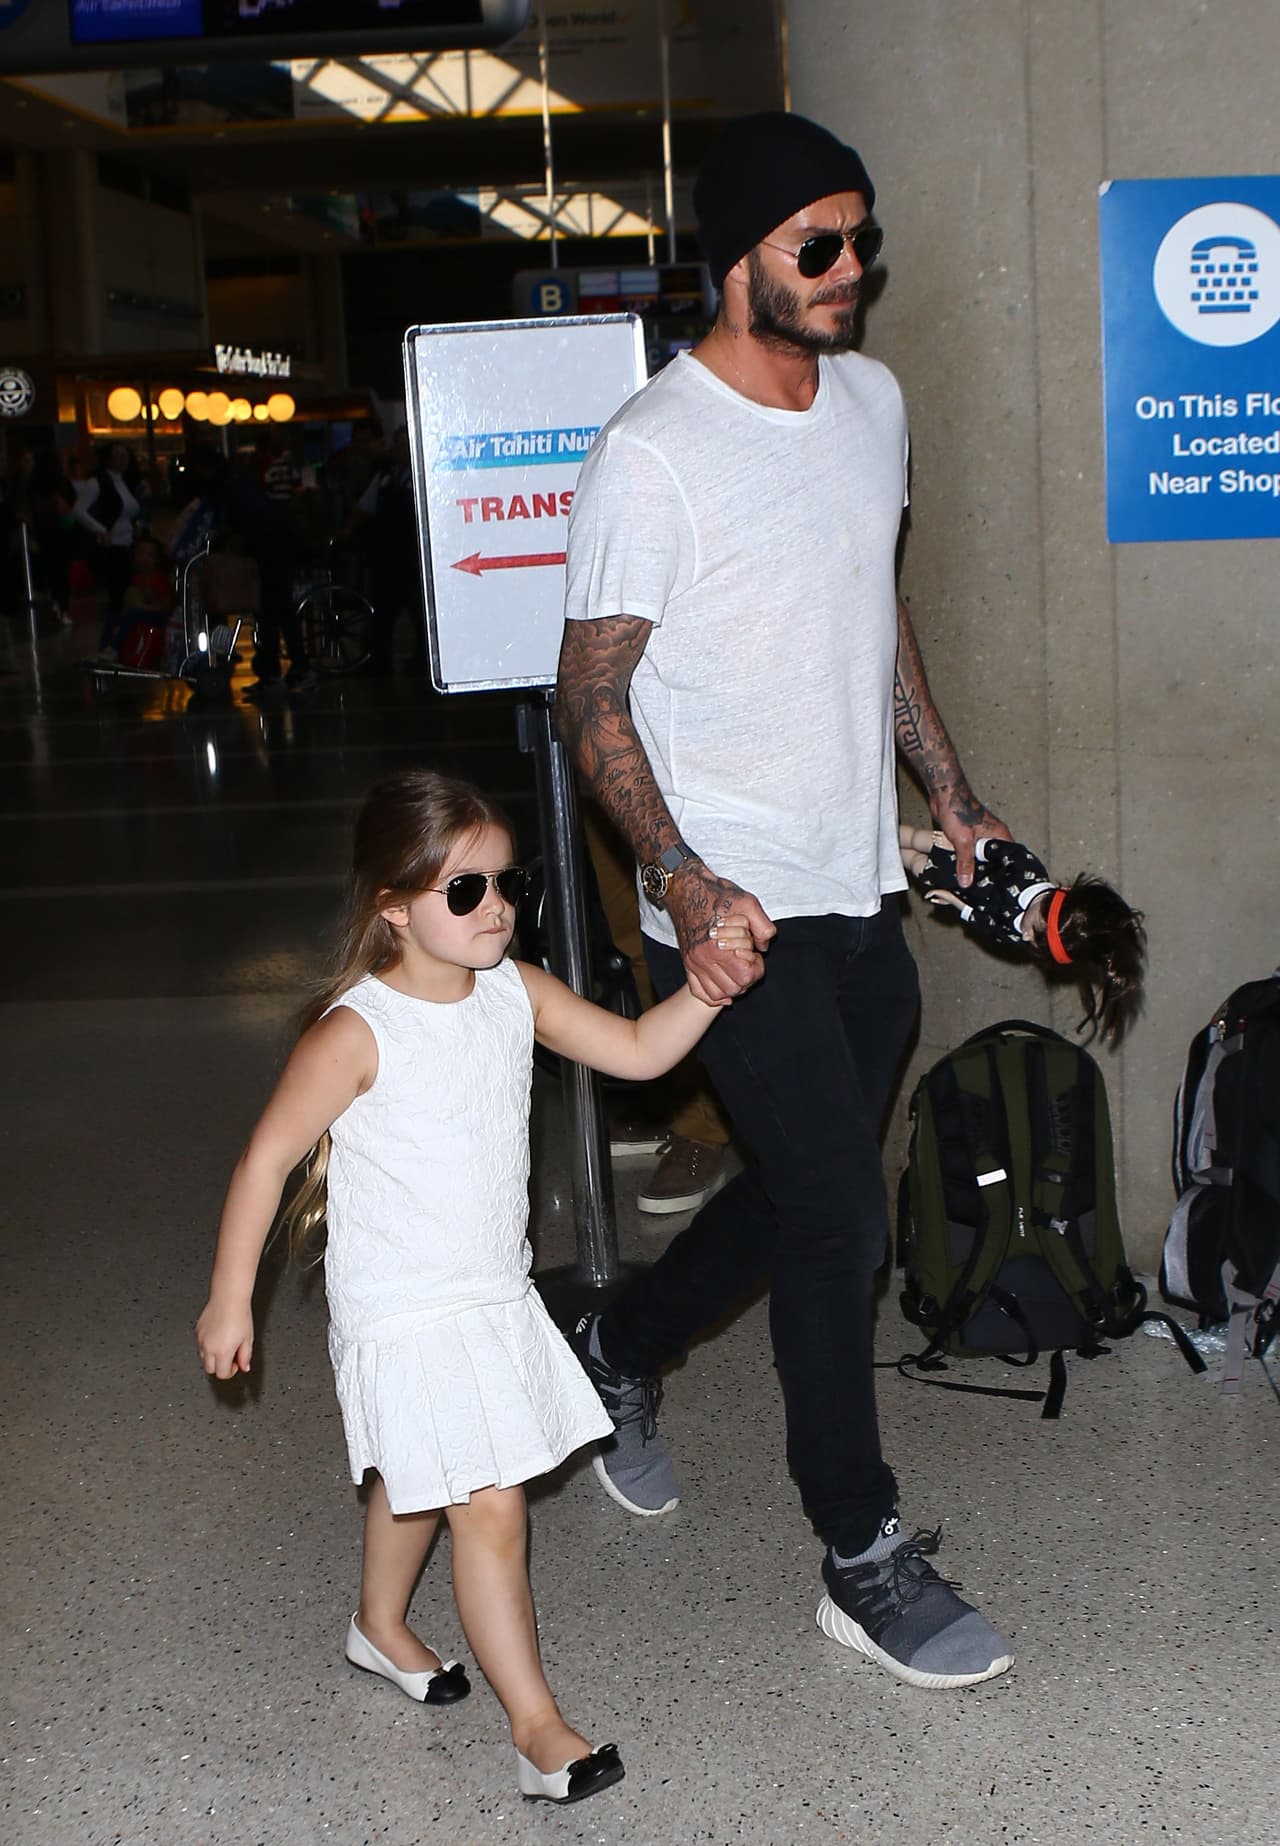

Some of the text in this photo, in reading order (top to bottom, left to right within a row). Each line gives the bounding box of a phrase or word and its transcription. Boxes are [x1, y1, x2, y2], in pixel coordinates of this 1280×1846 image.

[539, 284, 563, 312] B
[1136, 396, 1175, 420] On
[1179, 394, 1238, 419] This
[452, 438, 486, 460] Air
[491, 432, 552, 457] Tahiti
[1173, 431, 1280, 457] Located
[1149, 472, 1212, 496] Near
